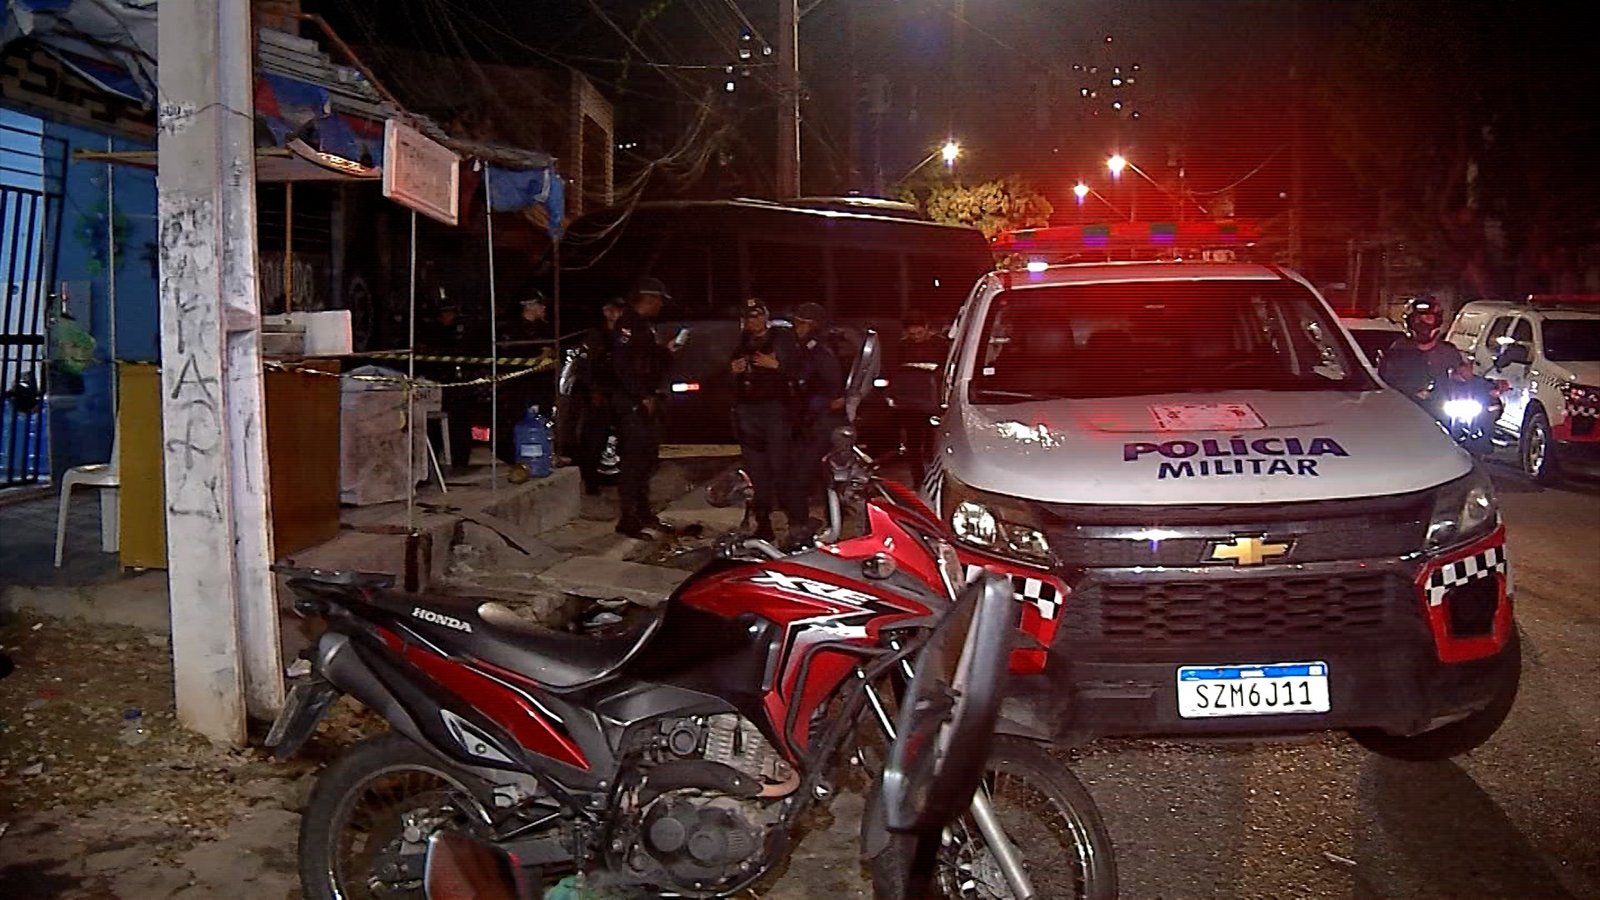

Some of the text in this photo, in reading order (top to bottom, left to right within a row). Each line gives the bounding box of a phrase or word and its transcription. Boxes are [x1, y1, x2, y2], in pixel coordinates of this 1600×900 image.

[1123, 435, 1350, 461] POLÍCIA
[1157, 459, 1319, 479] MILITAR
[750, 570, 880, 606] XRE
[411, 607, 473, 633] HONDA
[1196, 681, 1312, 709] SZM6J11
